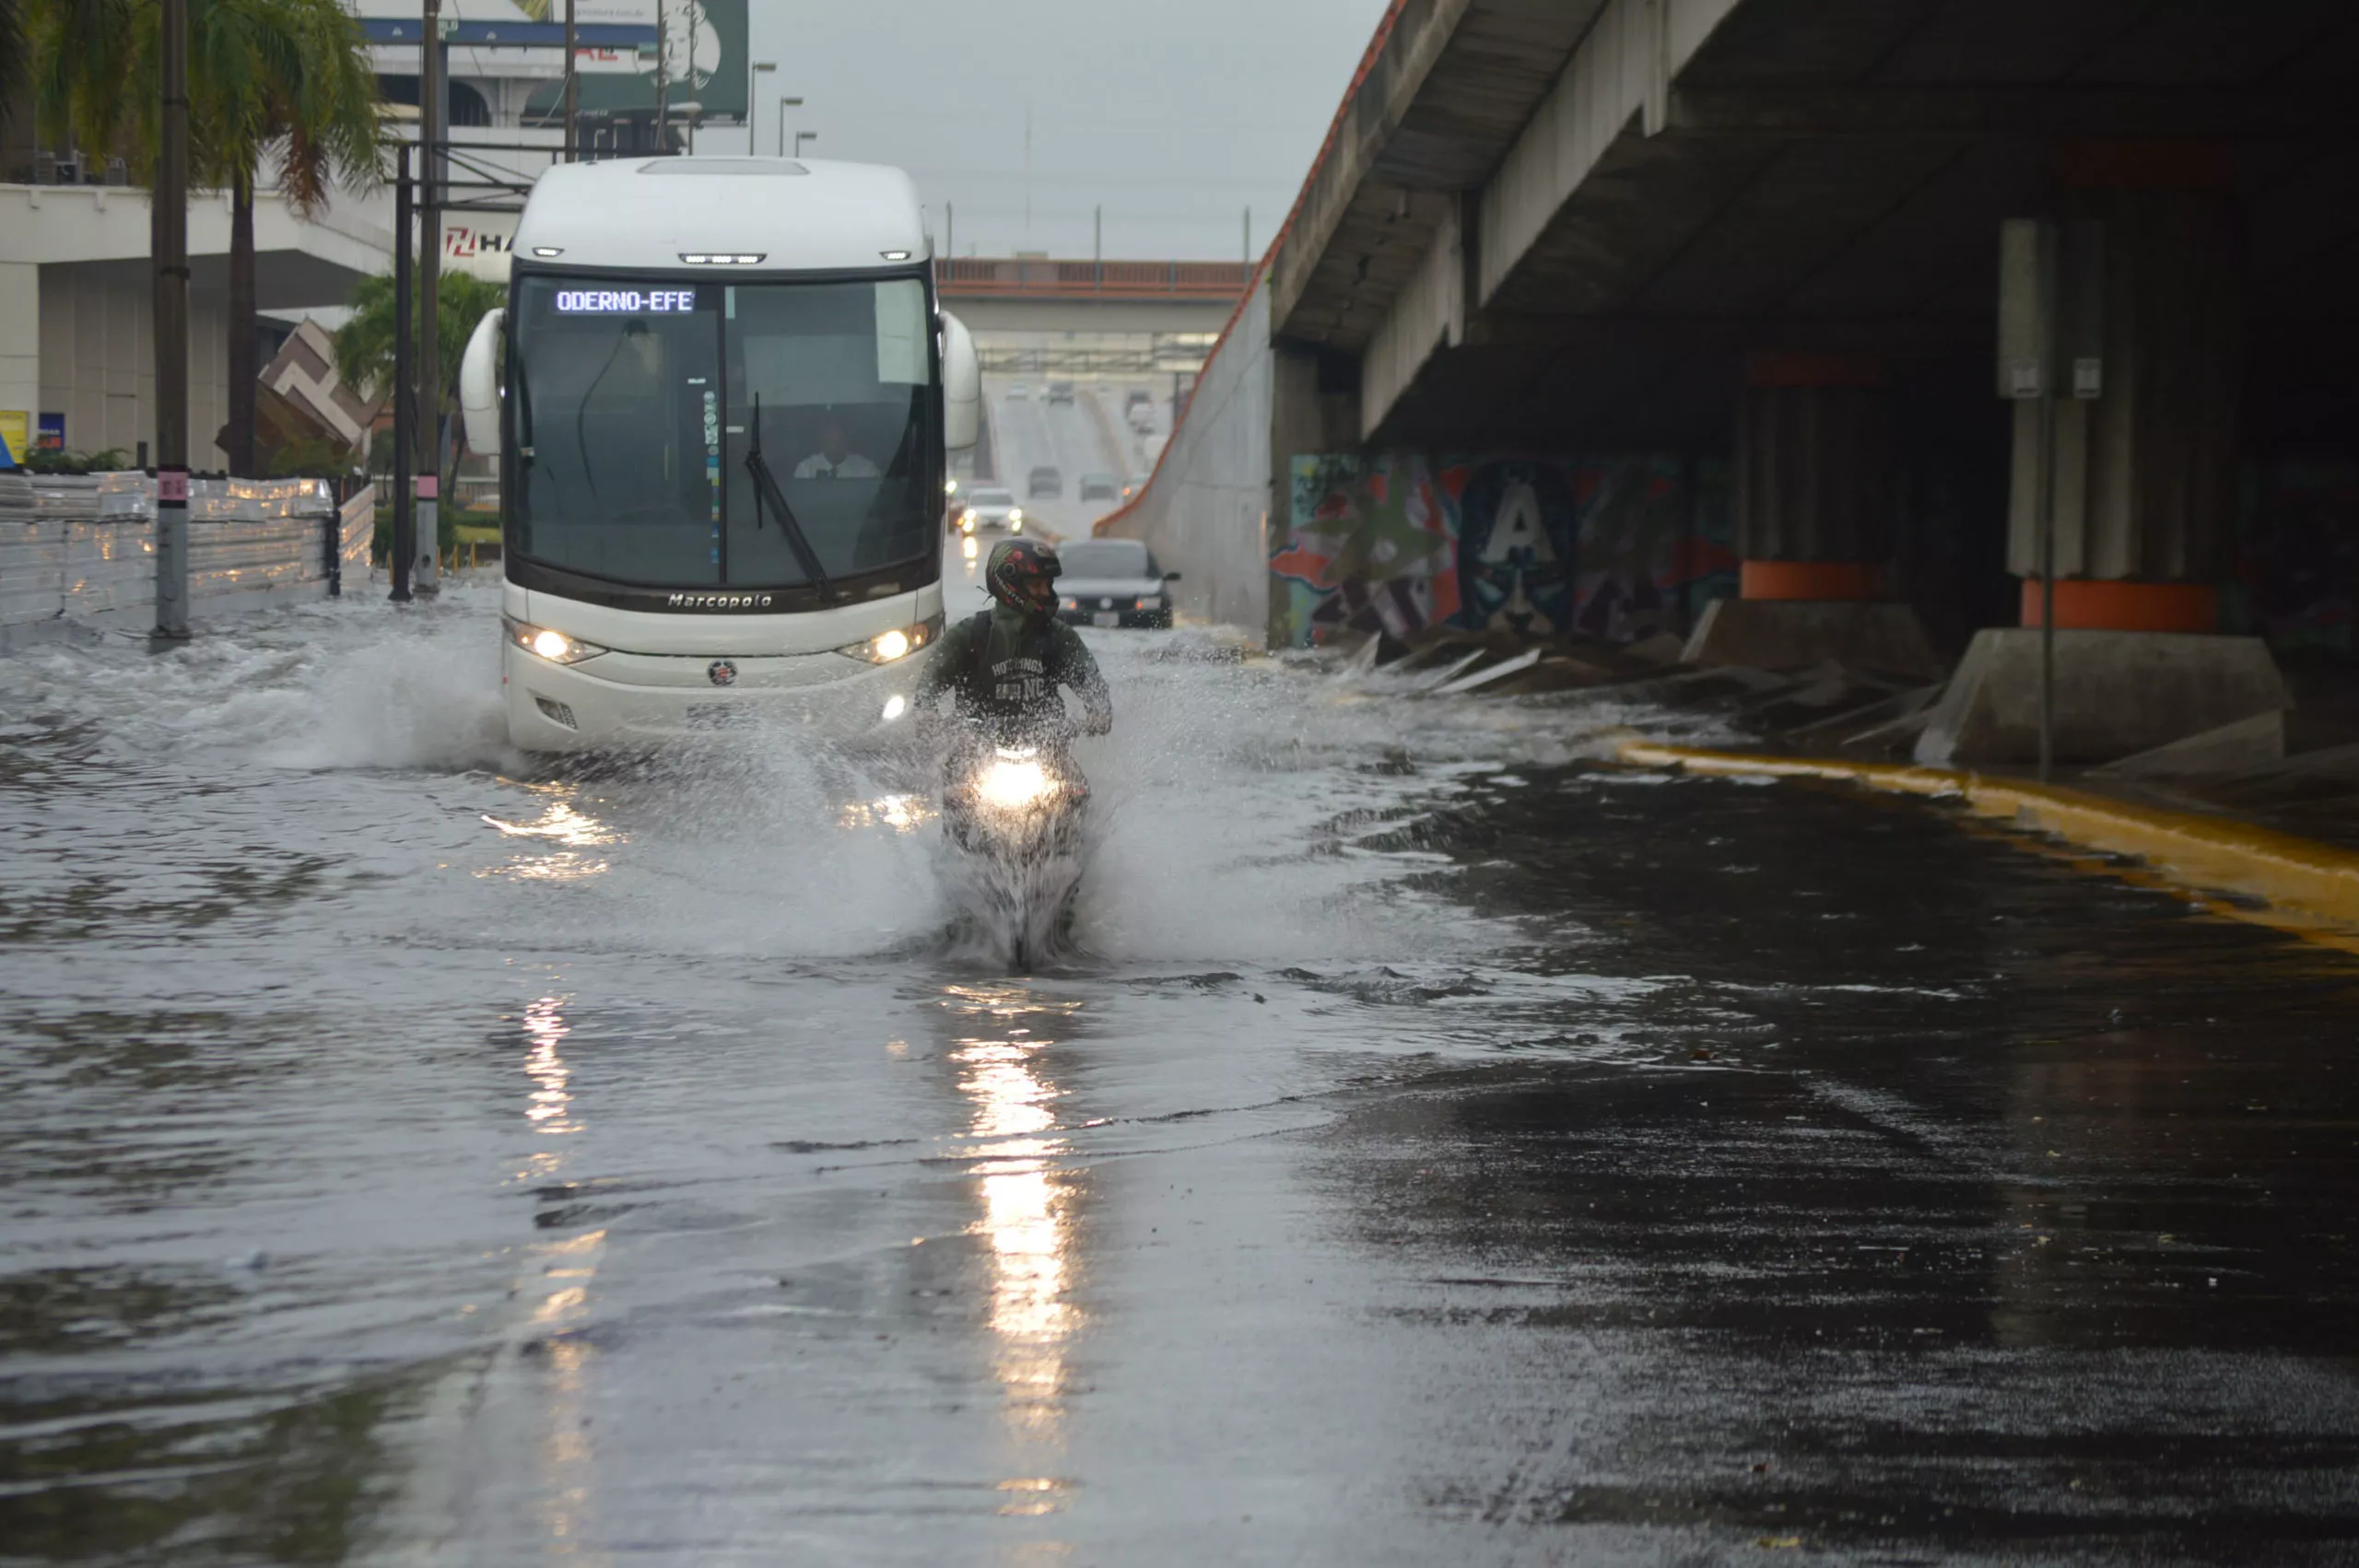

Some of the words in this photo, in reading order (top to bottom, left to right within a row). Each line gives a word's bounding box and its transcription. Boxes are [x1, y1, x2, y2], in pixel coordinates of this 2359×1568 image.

[556, 290, 695, 311] ODERNO-EFE
[1479, 481, 1557, 564] A
[667, 592, 772, 610] Marcopolo
